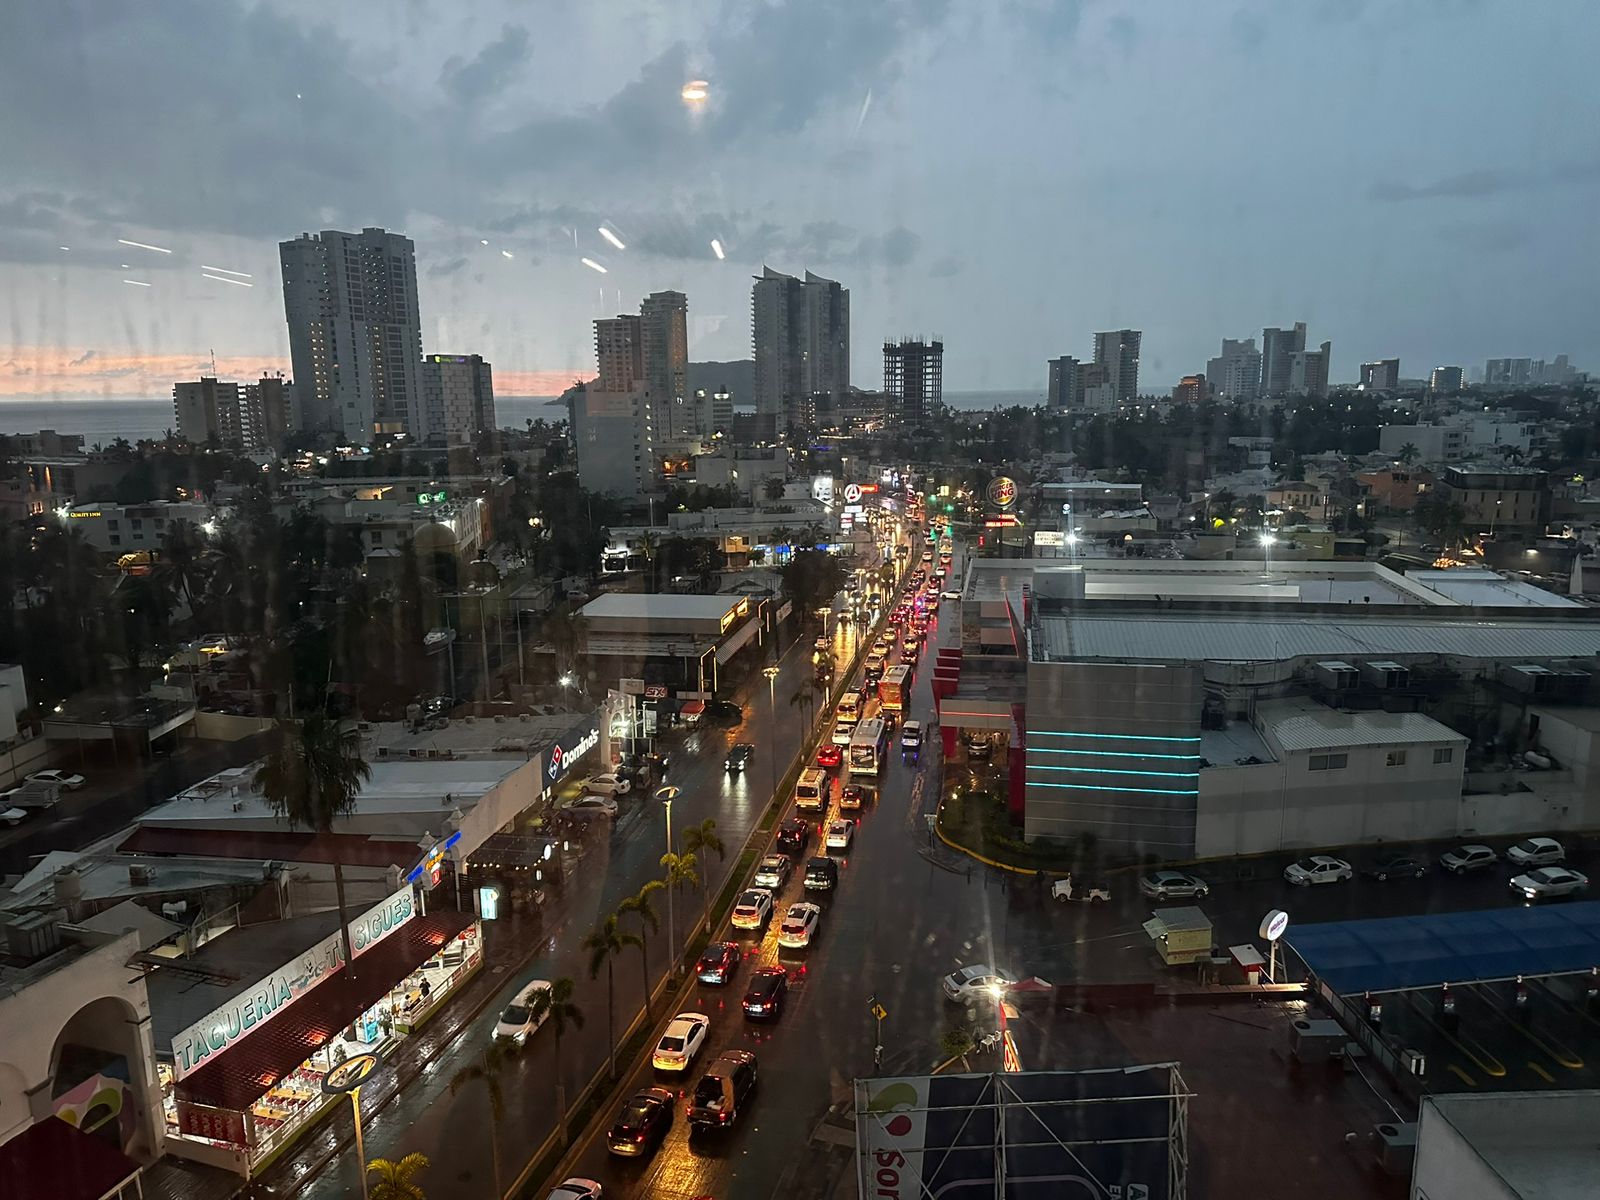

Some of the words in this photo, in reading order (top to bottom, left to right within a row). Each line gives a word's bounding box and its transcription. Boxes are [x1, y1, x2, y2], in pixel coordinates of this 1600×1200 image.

[646, 687, 666, 698] SIX
[562, 728, 599, 769] Domino's
[176, 976, 293, 1072] TAQUERÍA
[353, 893, 413, 951] SIGUES
[1517, 975, 1522, 983] 3
[1443, 982, 1448, 990] 2
